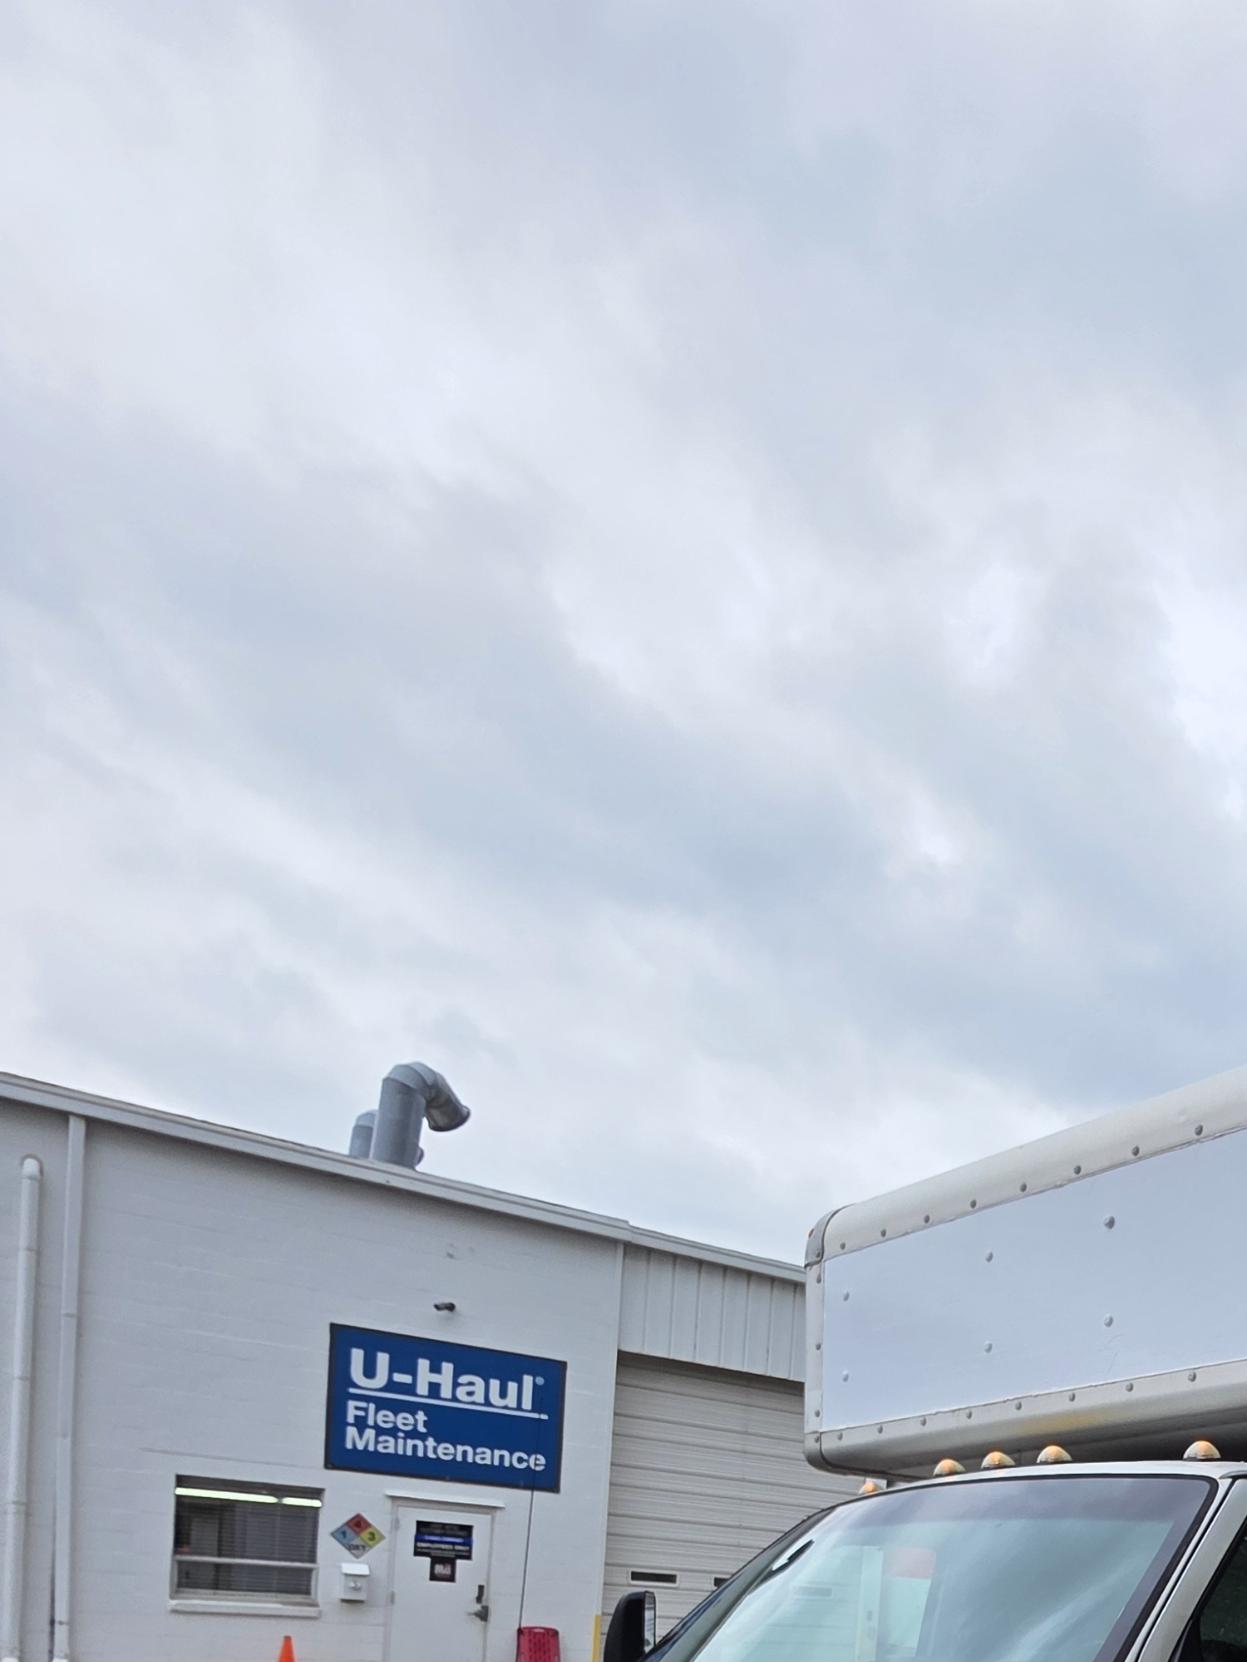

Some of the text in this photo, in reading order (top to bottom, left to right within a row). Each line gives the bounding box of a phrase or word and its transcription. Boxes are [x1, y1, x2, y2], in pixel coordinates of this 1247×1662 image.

[350, 1347, 534, 1411] U-Haul
[346, 1399, 428, 1433] Fleet
[345, 1425, 547, 1472] Maintenance
[368, 1531, 376, 1541] 3
